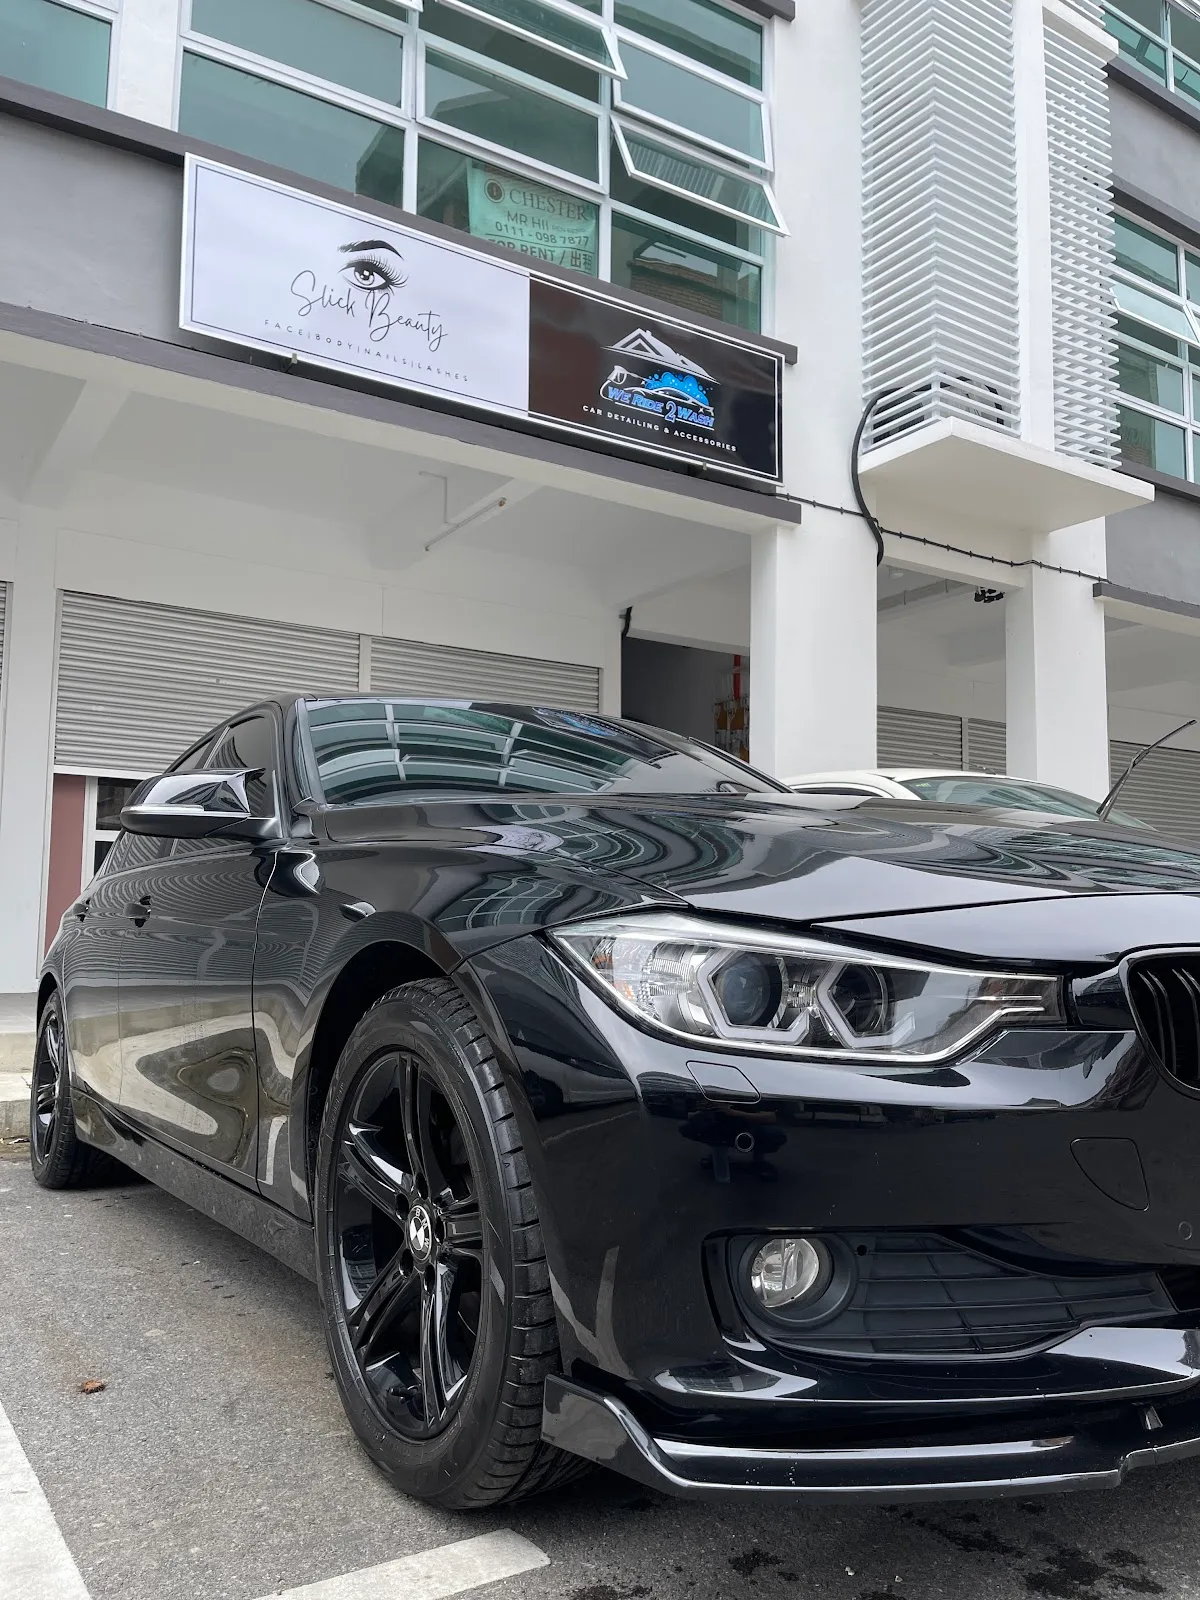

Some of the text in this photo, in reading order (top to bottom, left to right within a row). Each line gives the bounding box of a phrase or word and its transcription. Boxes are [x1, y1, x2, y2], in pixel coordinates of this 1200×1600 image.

[507, 210, 528, 226] MR
[532, 216, 549, 232] HII
[509, 188, 588, 221] CHESTER
[495, 221, 524, 237] 0111
[536, 231, 557, 244] 098
[560, 235, 590, 248] 7877
[570, 249, 593, 272] 出租
[290, 269, 449, 353] Slick Beauty
[608, 386, 715, 428] WE RIDE 2 WASH
[582, 404, 737, 453] CAR DETAILING & ACCESSORIES
[415, 1207, 430, 1249] BMW
